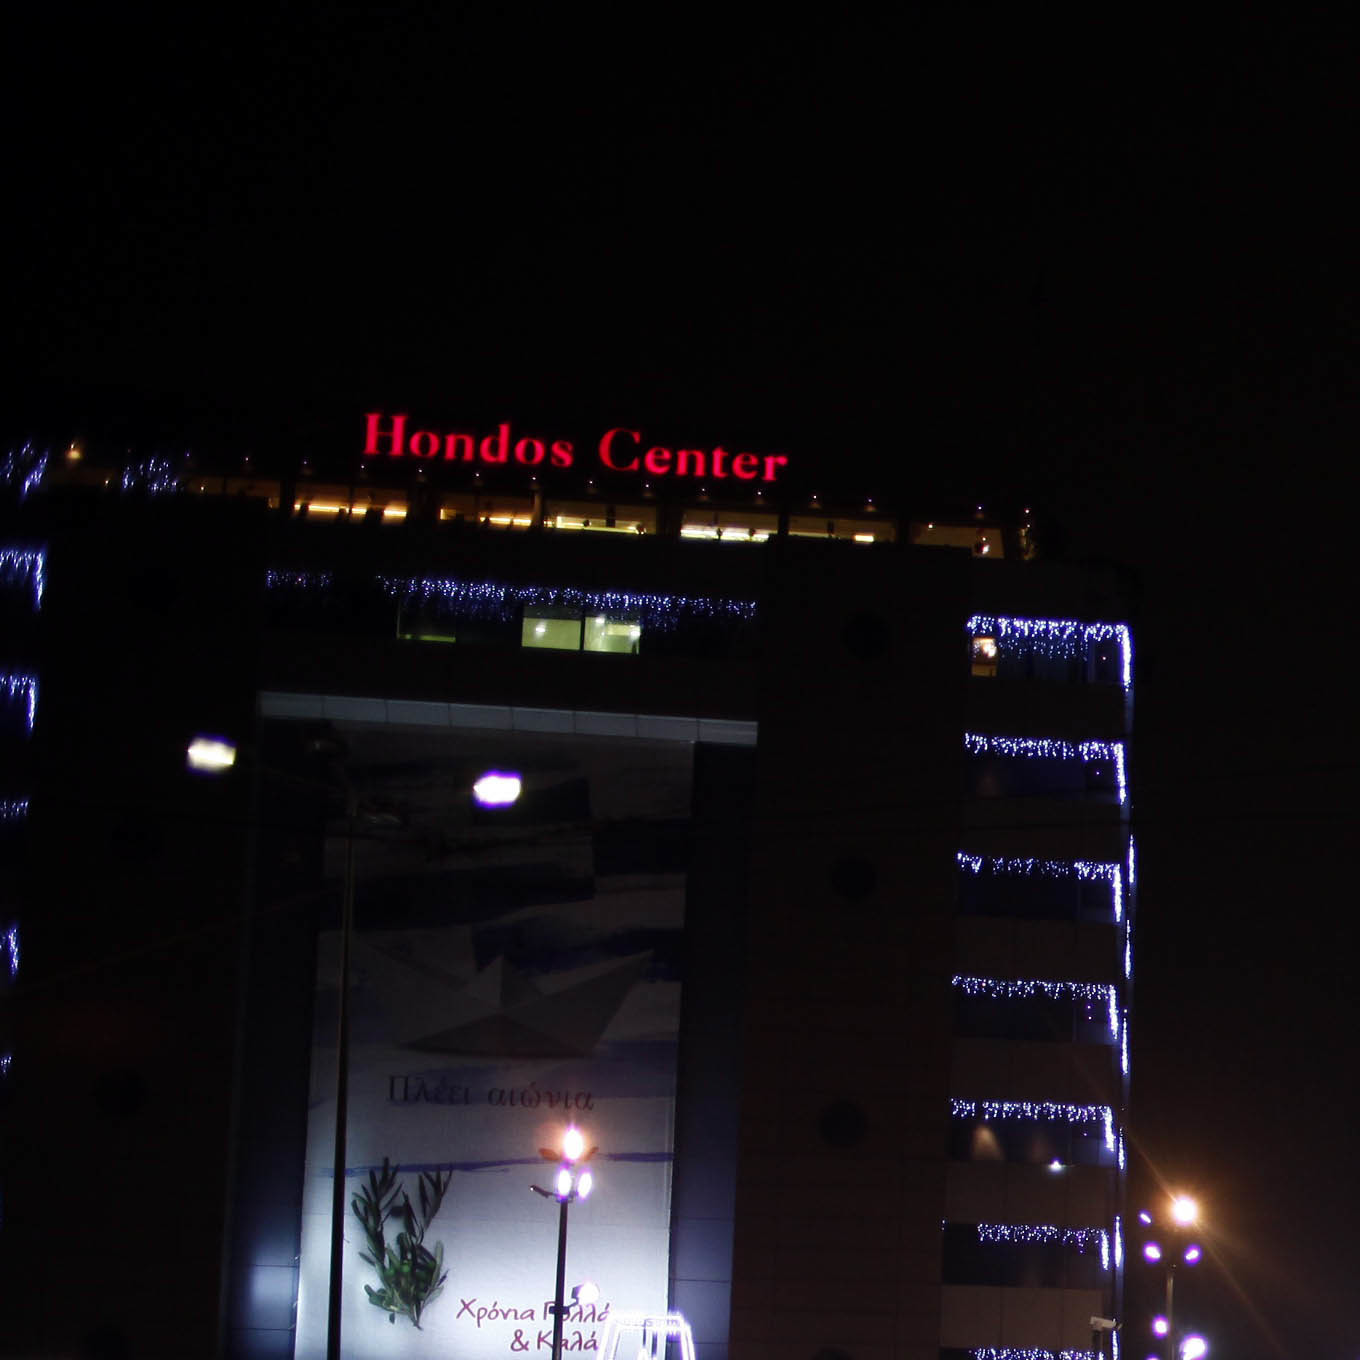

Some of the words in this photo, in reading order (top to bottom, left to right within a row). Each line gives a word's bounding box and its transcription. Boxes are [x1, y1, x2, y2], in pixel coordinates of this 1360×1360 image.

[363, 410, 575, 468] Hondos
[598, 426, 790, 483] Center
[456, 1298, 536, 1327] Χρόνια
[510, 1329, 530, 1352] &
